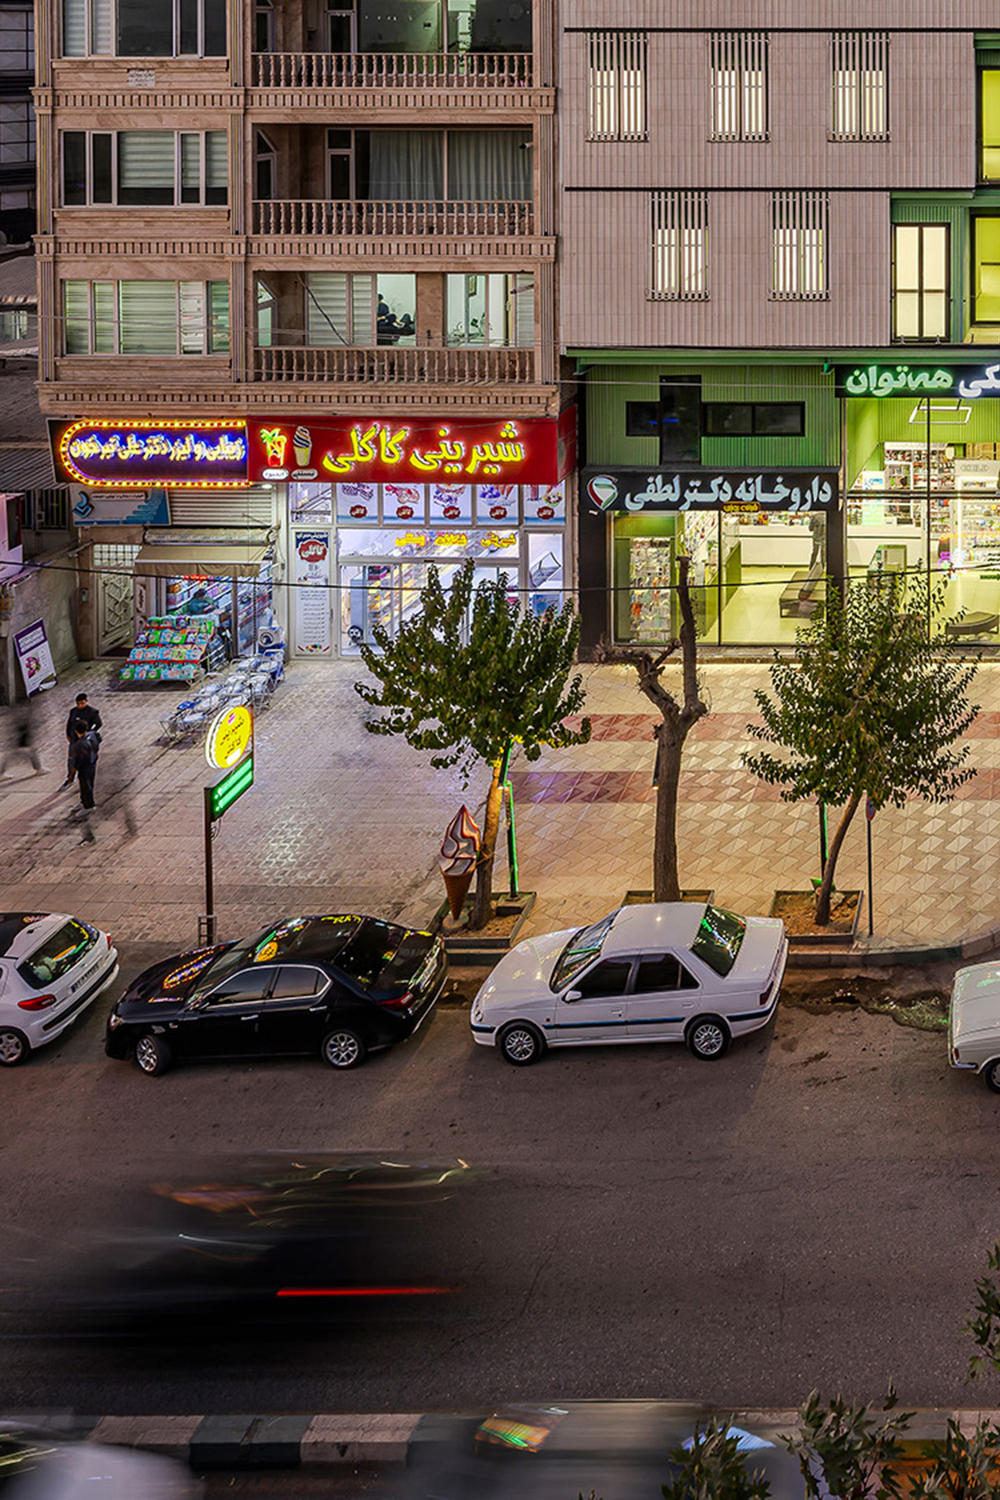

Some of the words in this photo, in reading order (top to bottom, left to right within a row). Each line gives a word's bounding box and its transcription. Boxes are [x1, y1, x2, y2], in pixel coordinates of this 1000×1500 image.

[117, 434, 143, 460] علی
[143, 435, 168, 461] دکتر
[169, 434, 193, 461] لیزر
[195, 441, 205, 461] و
[410, 421, 524, 475] شیرینی
[624, 474, 681, 511] لطفی
[678, 476, 733, 511] دکتر
[735, 475, 832, 511] داروخانه
[395, 532, 426, 547] بستنی
